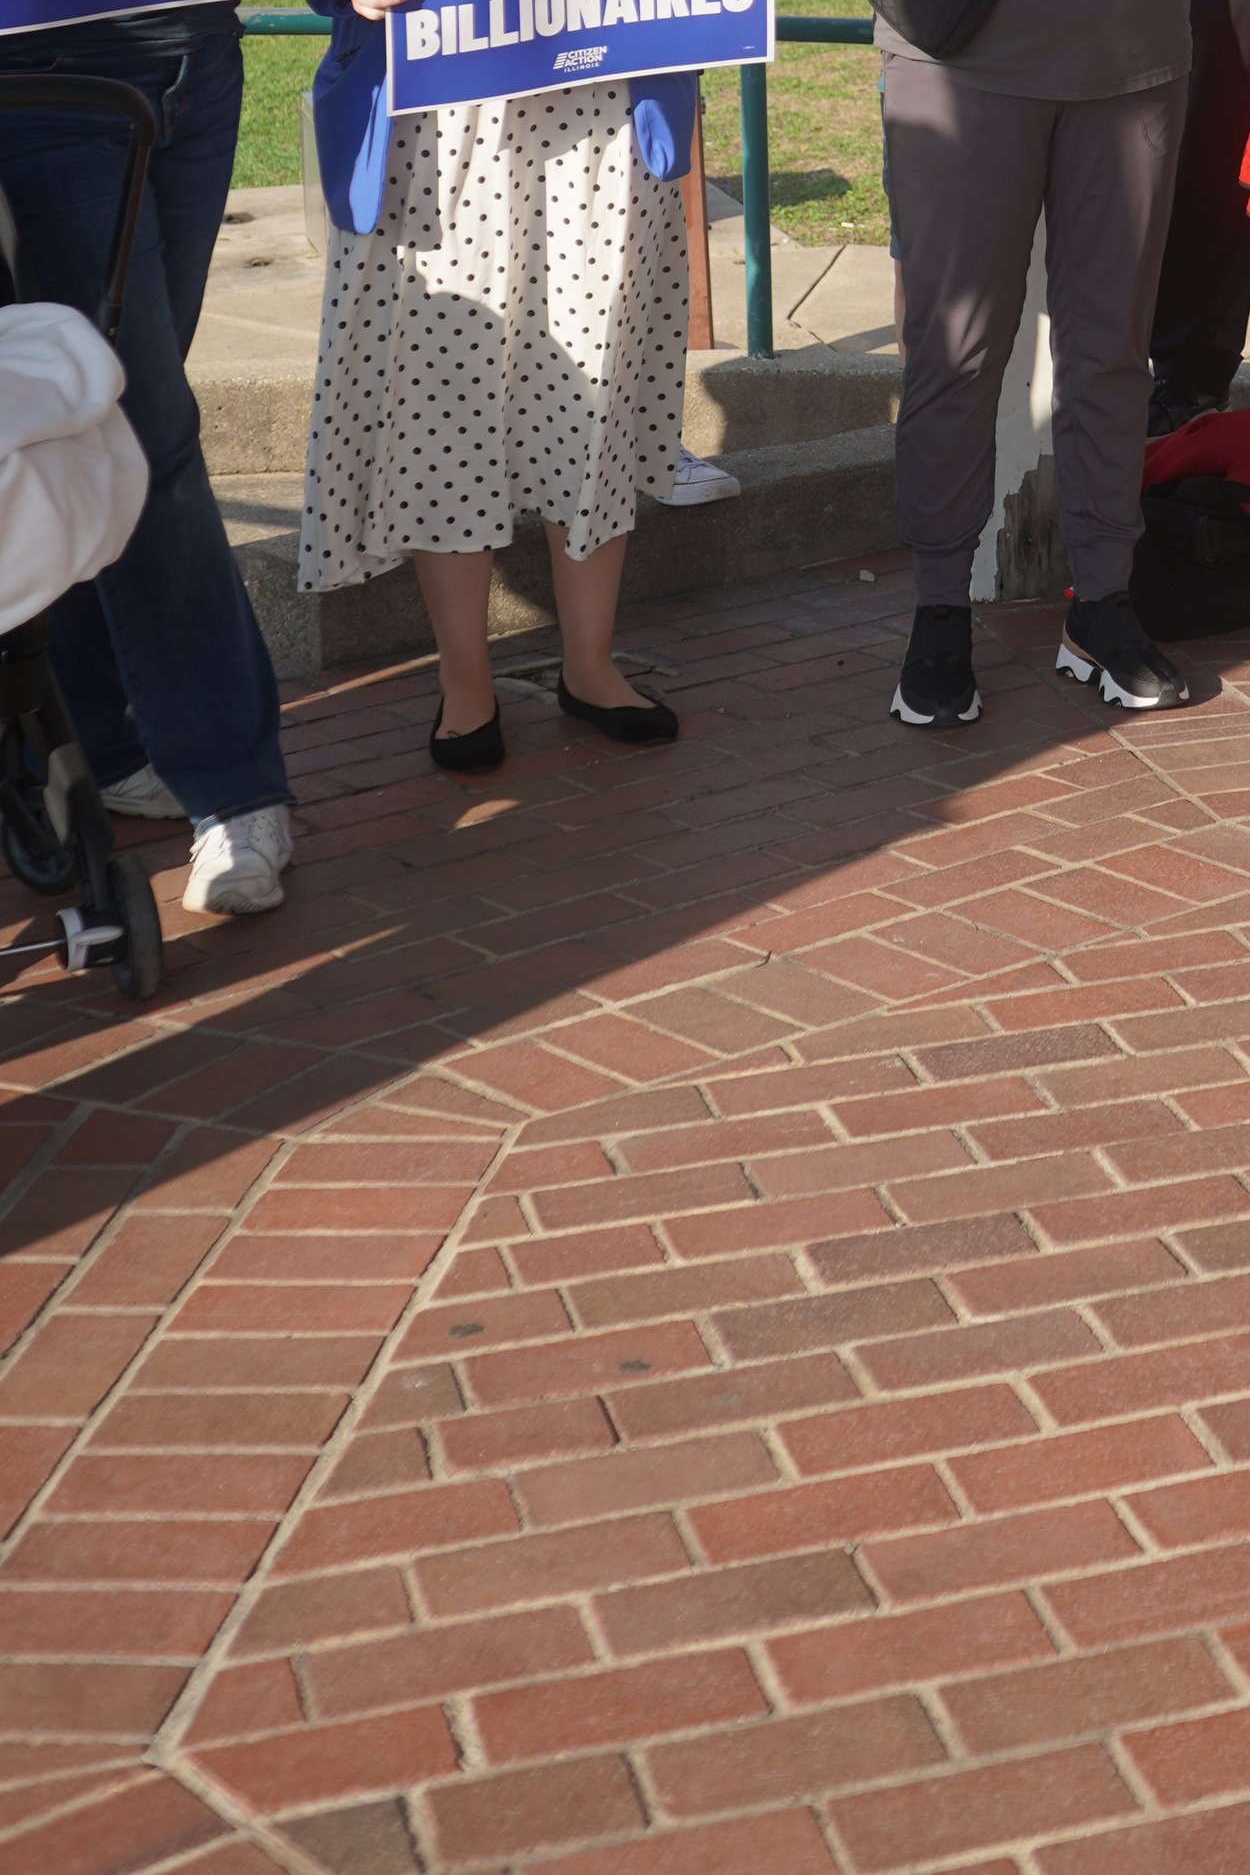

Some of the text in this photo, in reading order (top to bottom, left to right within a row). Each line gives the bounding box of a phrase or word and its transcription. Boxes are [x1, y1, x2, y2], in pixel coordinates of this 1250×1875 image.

[568, 46, 607, 59] CITIZEN
[565, 54, 602, 67] ACTION
[564, 62, 599, 73] ILLINOIS
